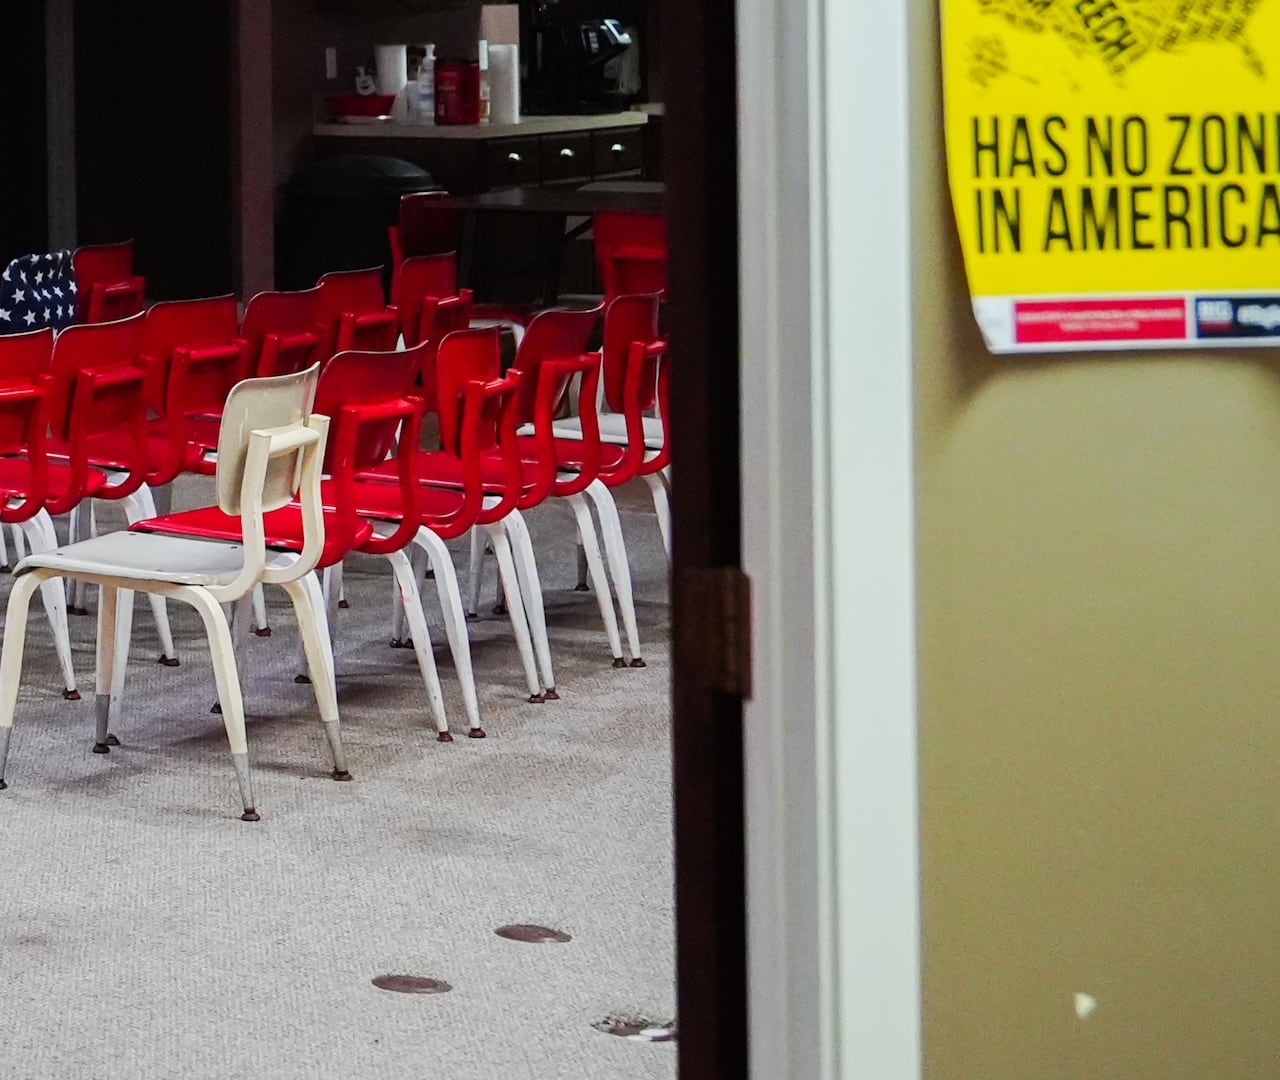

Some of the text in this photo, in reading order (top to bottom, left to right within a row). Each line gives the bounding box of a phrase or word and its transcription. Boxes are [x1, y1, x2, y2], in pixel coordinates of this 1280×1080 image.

[973, 114, 1280, 177] HAS NO ZON
[975, 183, 1280, 253] IN AMERICA
